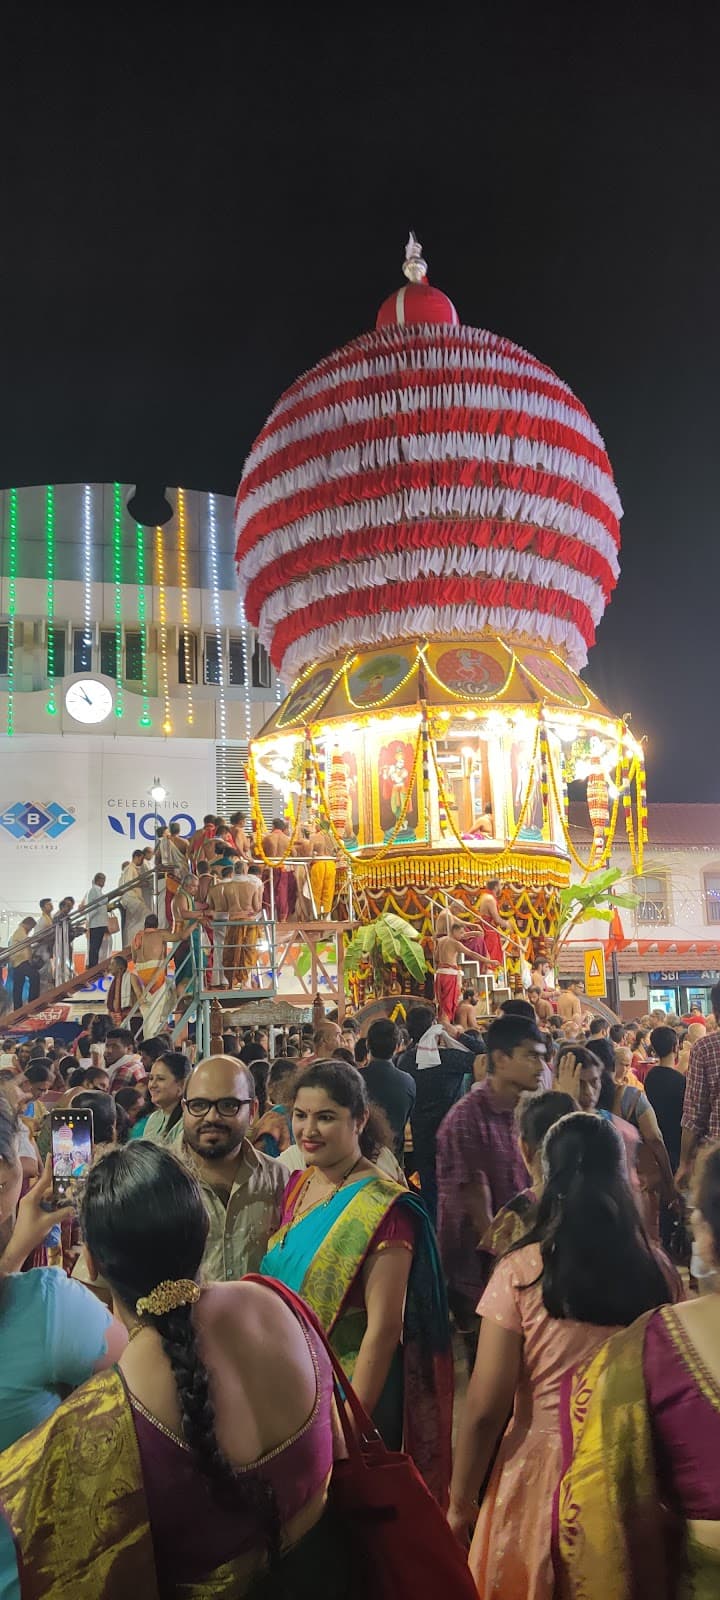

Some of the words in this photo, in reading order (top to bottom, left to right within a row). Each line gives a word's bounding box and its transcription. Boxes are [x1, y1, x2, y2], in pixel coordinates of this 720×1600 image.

[2, 813, 70, 825] SBC
[126, 812, 197, 841] 100
[661, 971, 679, 981] SBI
